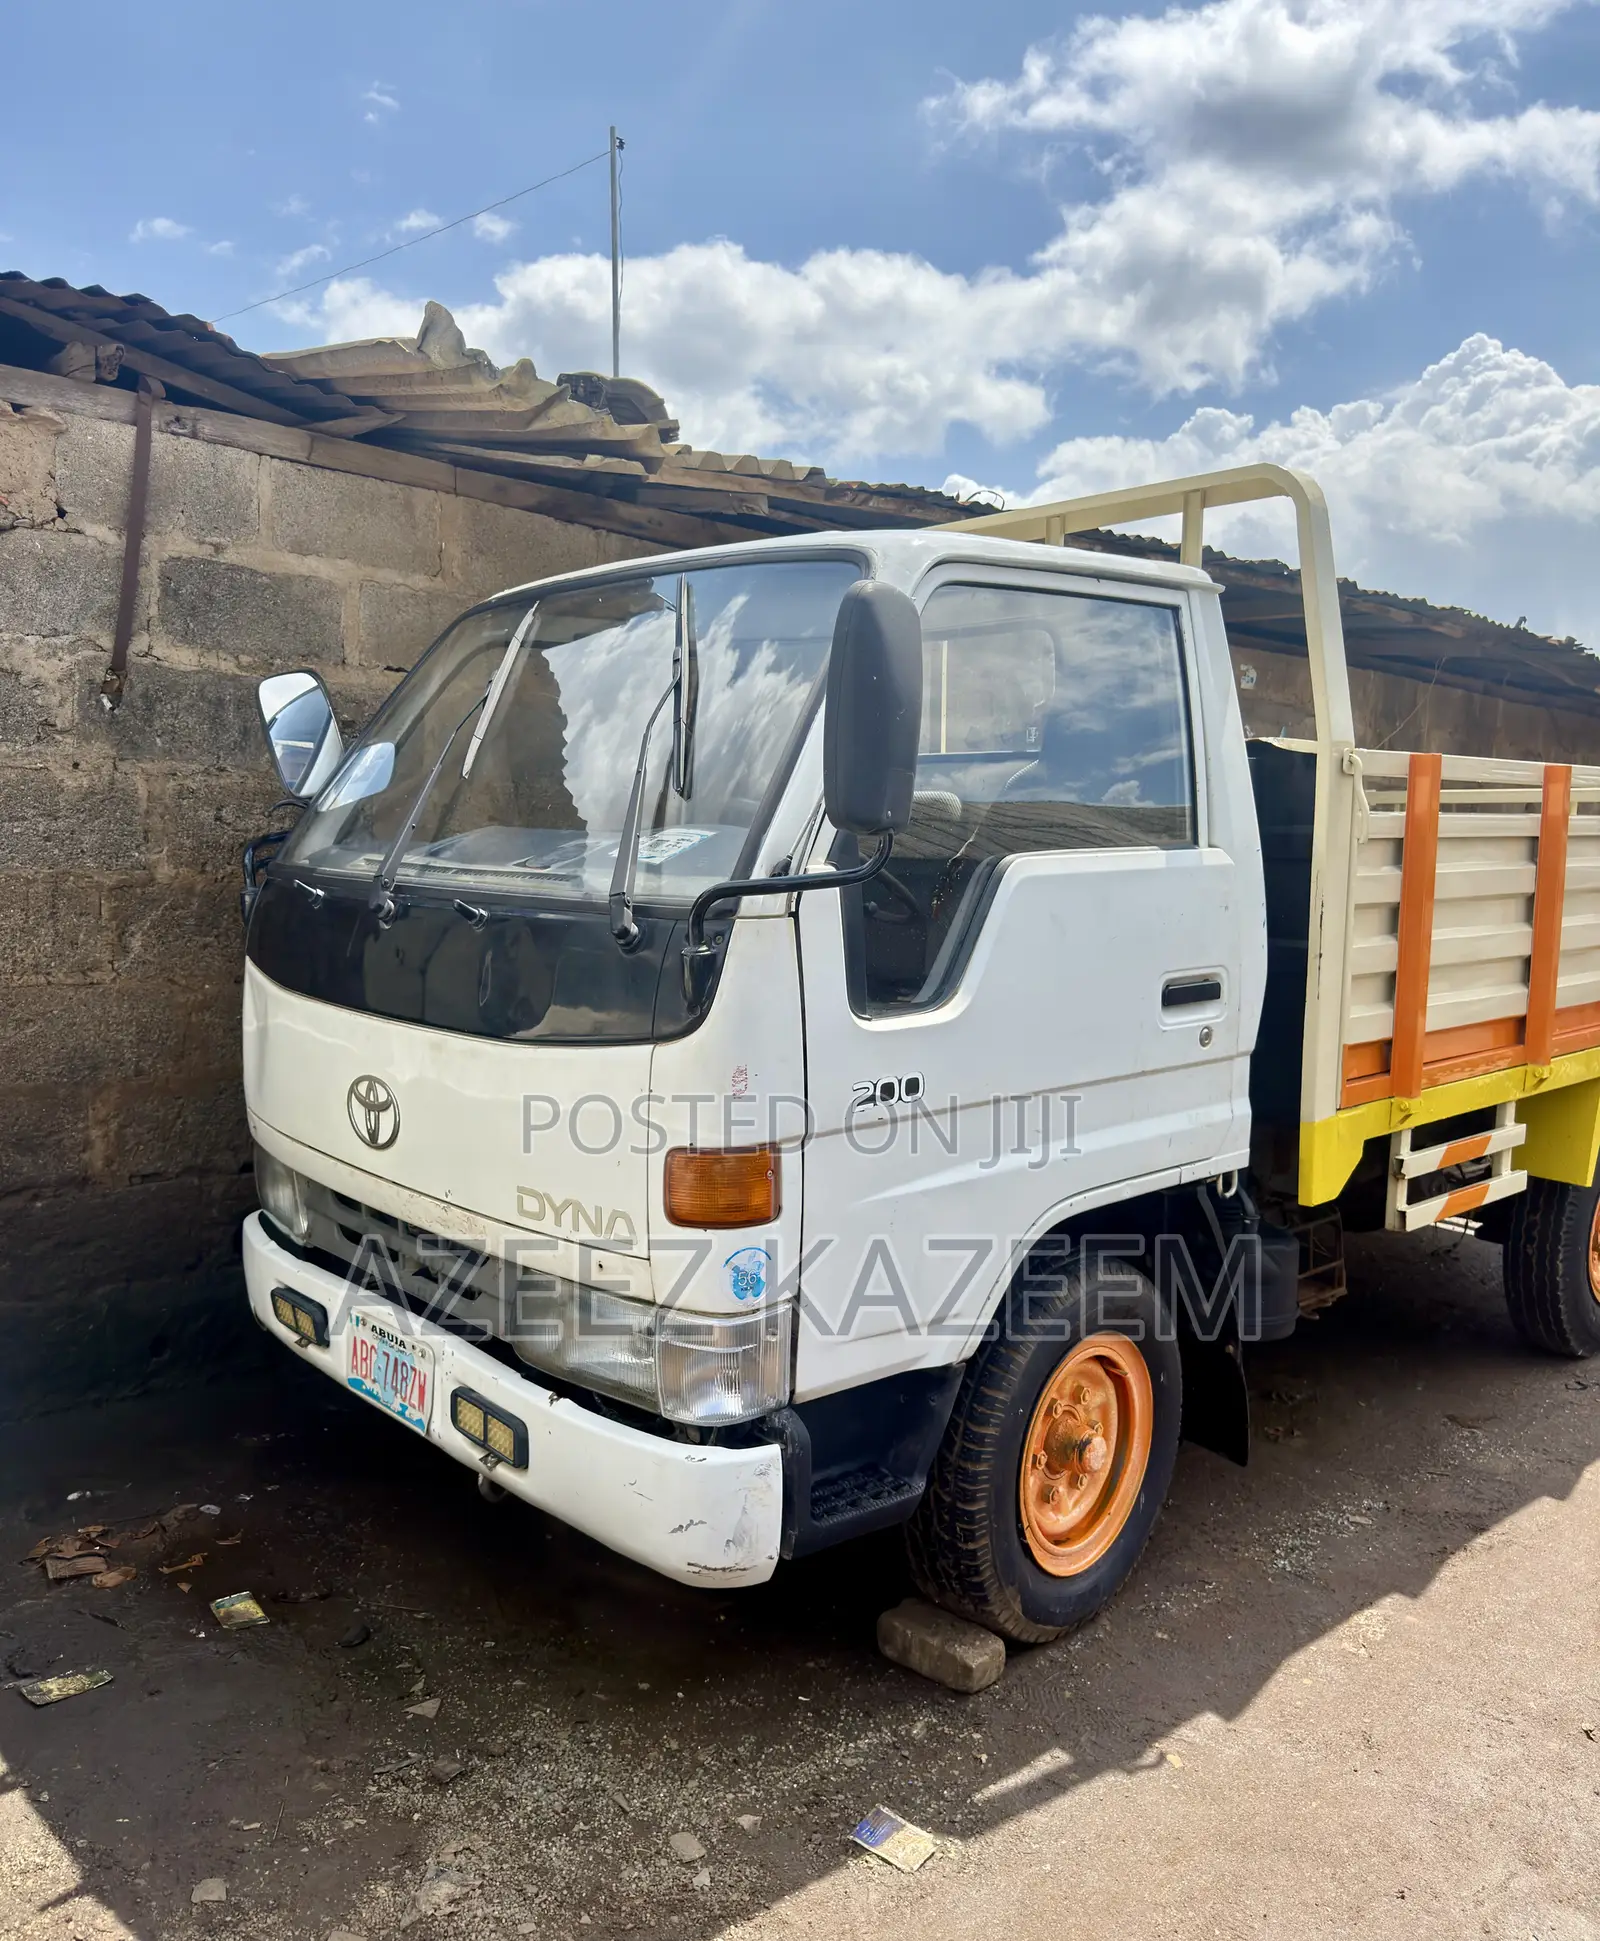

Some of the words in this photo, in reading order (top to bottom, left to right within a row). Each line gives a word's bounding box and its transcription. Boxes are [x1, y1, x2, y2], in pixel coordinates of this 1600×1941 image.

[852, 1070, 925, 1113] 200
[516, 1185, 638, 1245] DYNA
[738, 1270, 757, 1286] 56
[371, 1324, 407, 1350] ABUJA
